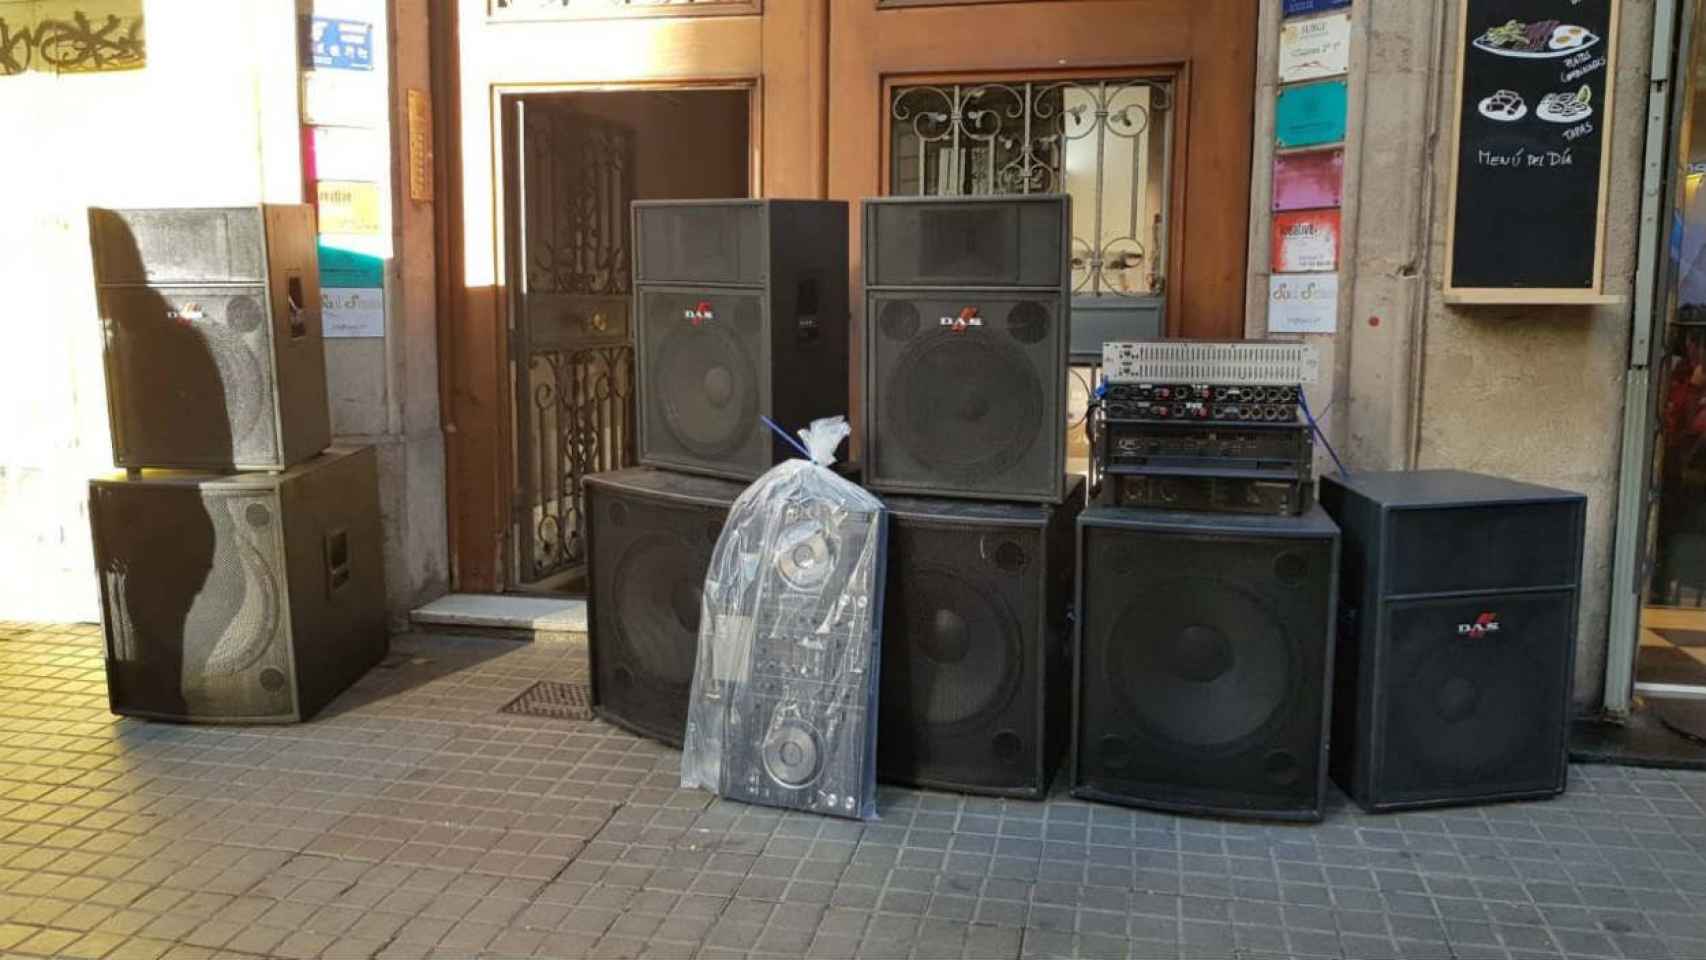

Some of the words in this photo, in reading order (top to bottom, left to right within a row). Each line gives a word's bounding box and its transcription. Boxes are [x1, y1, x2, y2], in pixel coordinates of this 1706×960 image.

[1562, 122, 1593, 141] TAPAS
[685, 310, 713, 319] DAS
[940, 317, 982, 326] DAS
[1458, 622, 1500, 633] DAS
